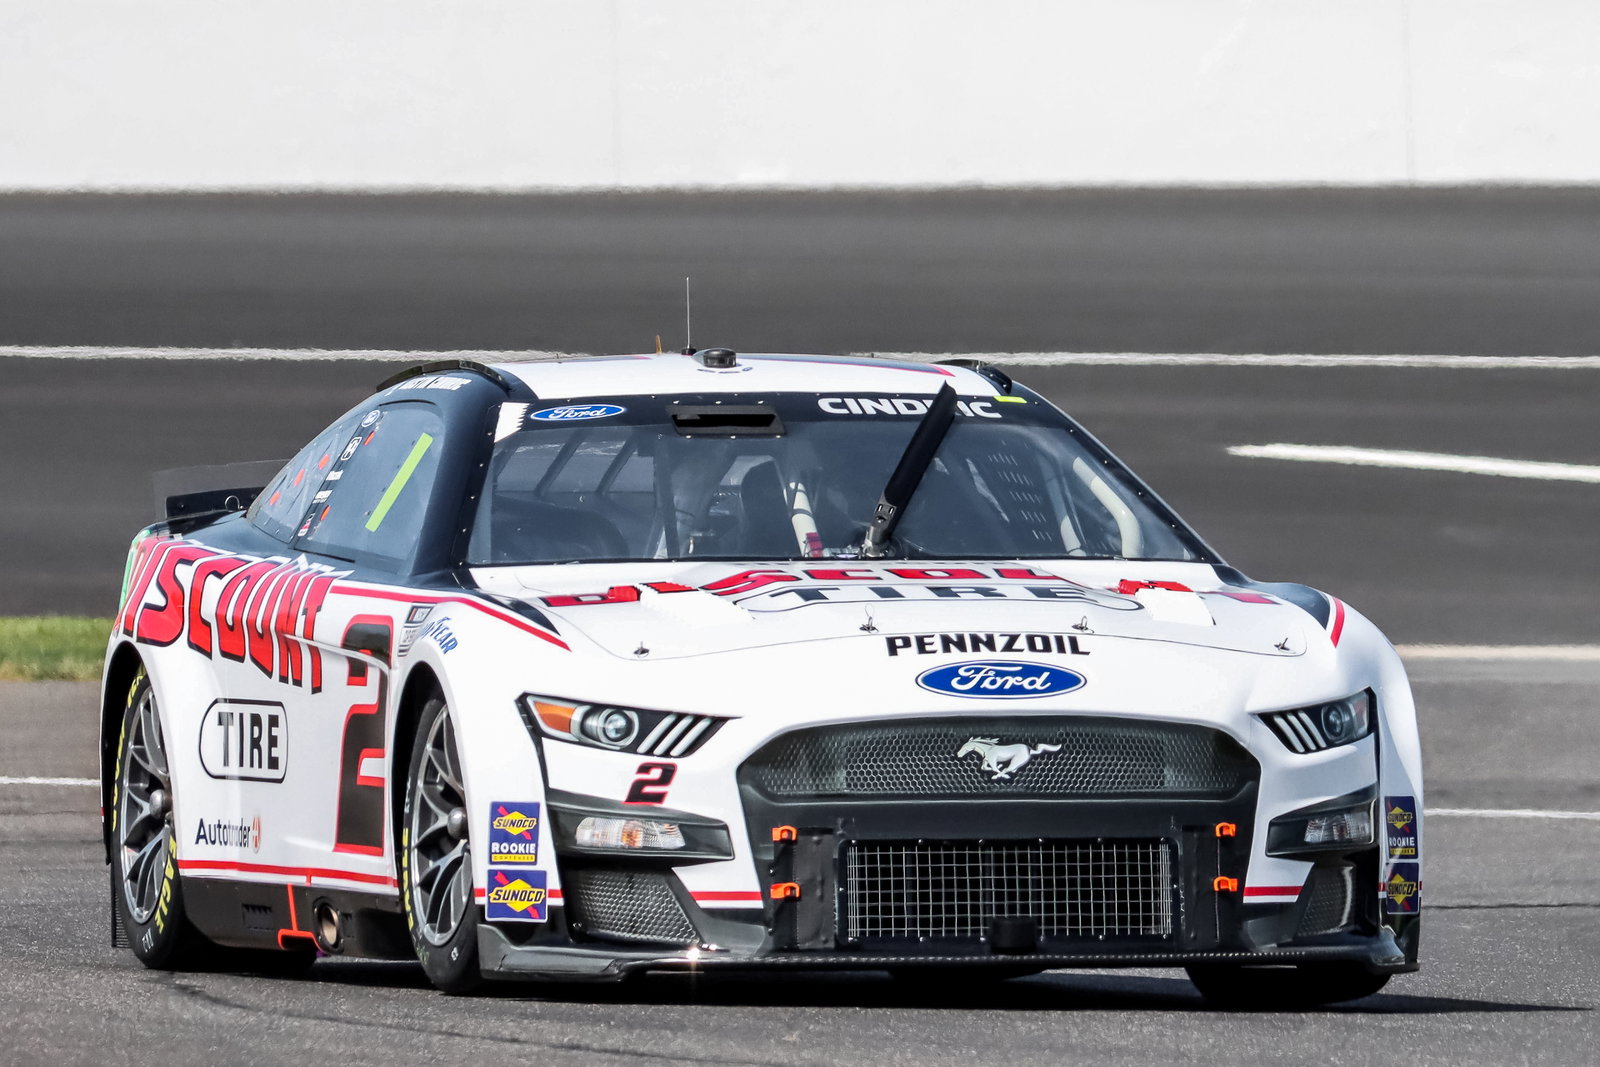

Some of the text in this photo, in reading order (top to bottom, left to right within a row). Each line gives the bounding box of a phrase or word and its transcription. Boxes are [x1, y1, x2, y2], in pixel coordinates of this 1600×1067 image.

[548, 405, 608, 419] Ford
[817, 397, 1002, 418] CINDIC
[885, 633, 1091, 657] PENNZOIL
[950, 664, 1051, 691] Ford
[217, 711, 280, 770] TIRE
[331, 613, 394, 857] 2
[623, 761, 678, 804] 2
[494, 818, 536, 828] SUNOCO
[491, 841, 537, 854] ROOKIE
[492, 888, 544, 903] SUNOCO
